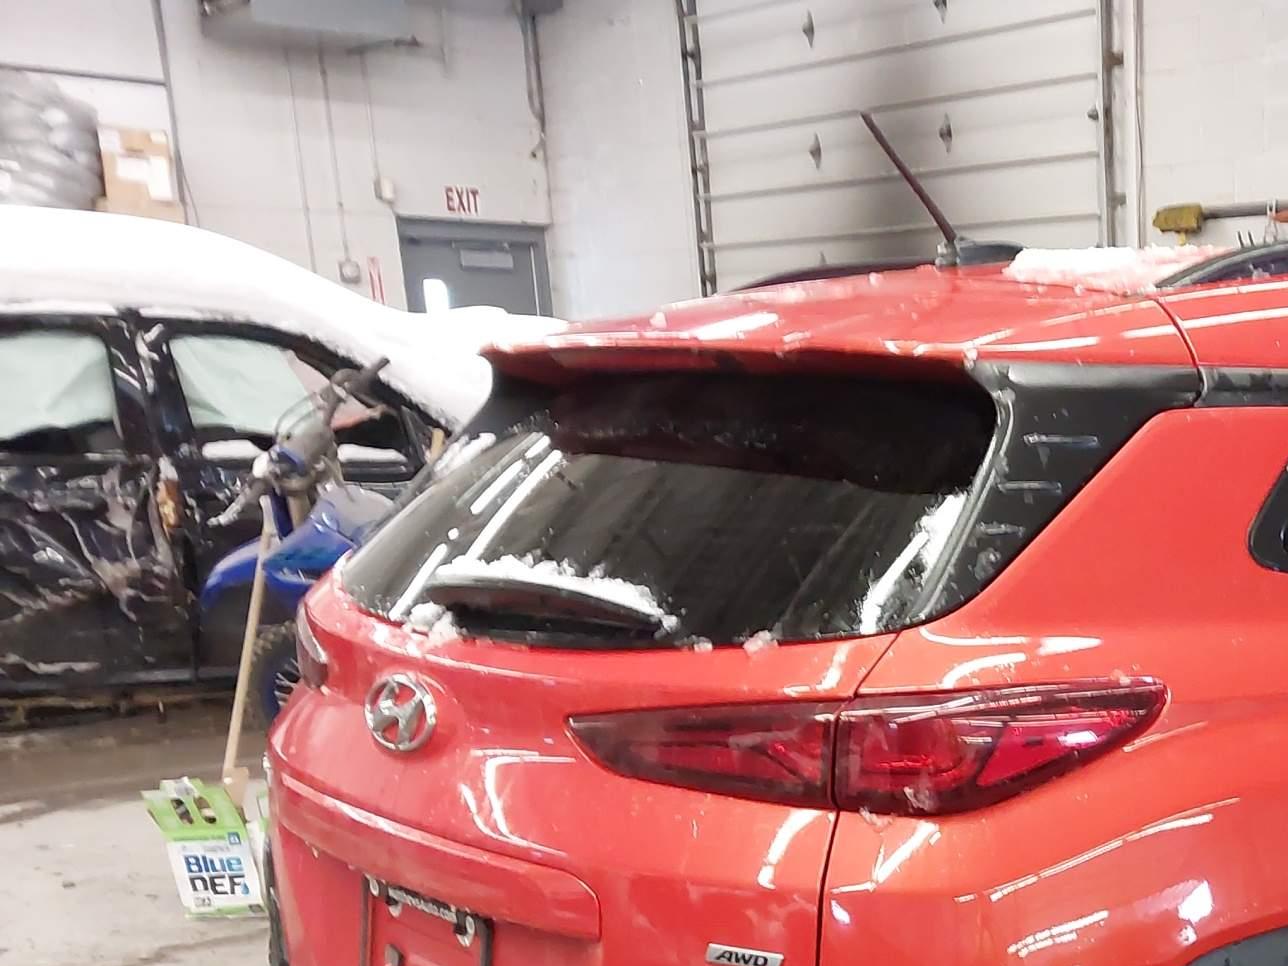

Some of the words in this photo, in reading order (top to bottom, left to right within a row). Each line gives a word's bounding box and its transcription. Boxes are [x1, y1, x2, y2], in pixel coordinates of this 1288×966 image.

[445, 186, 479, 213] EXIT
[184, 855, 244, 873] Blue
[716, 950, 768, 966] AWD
